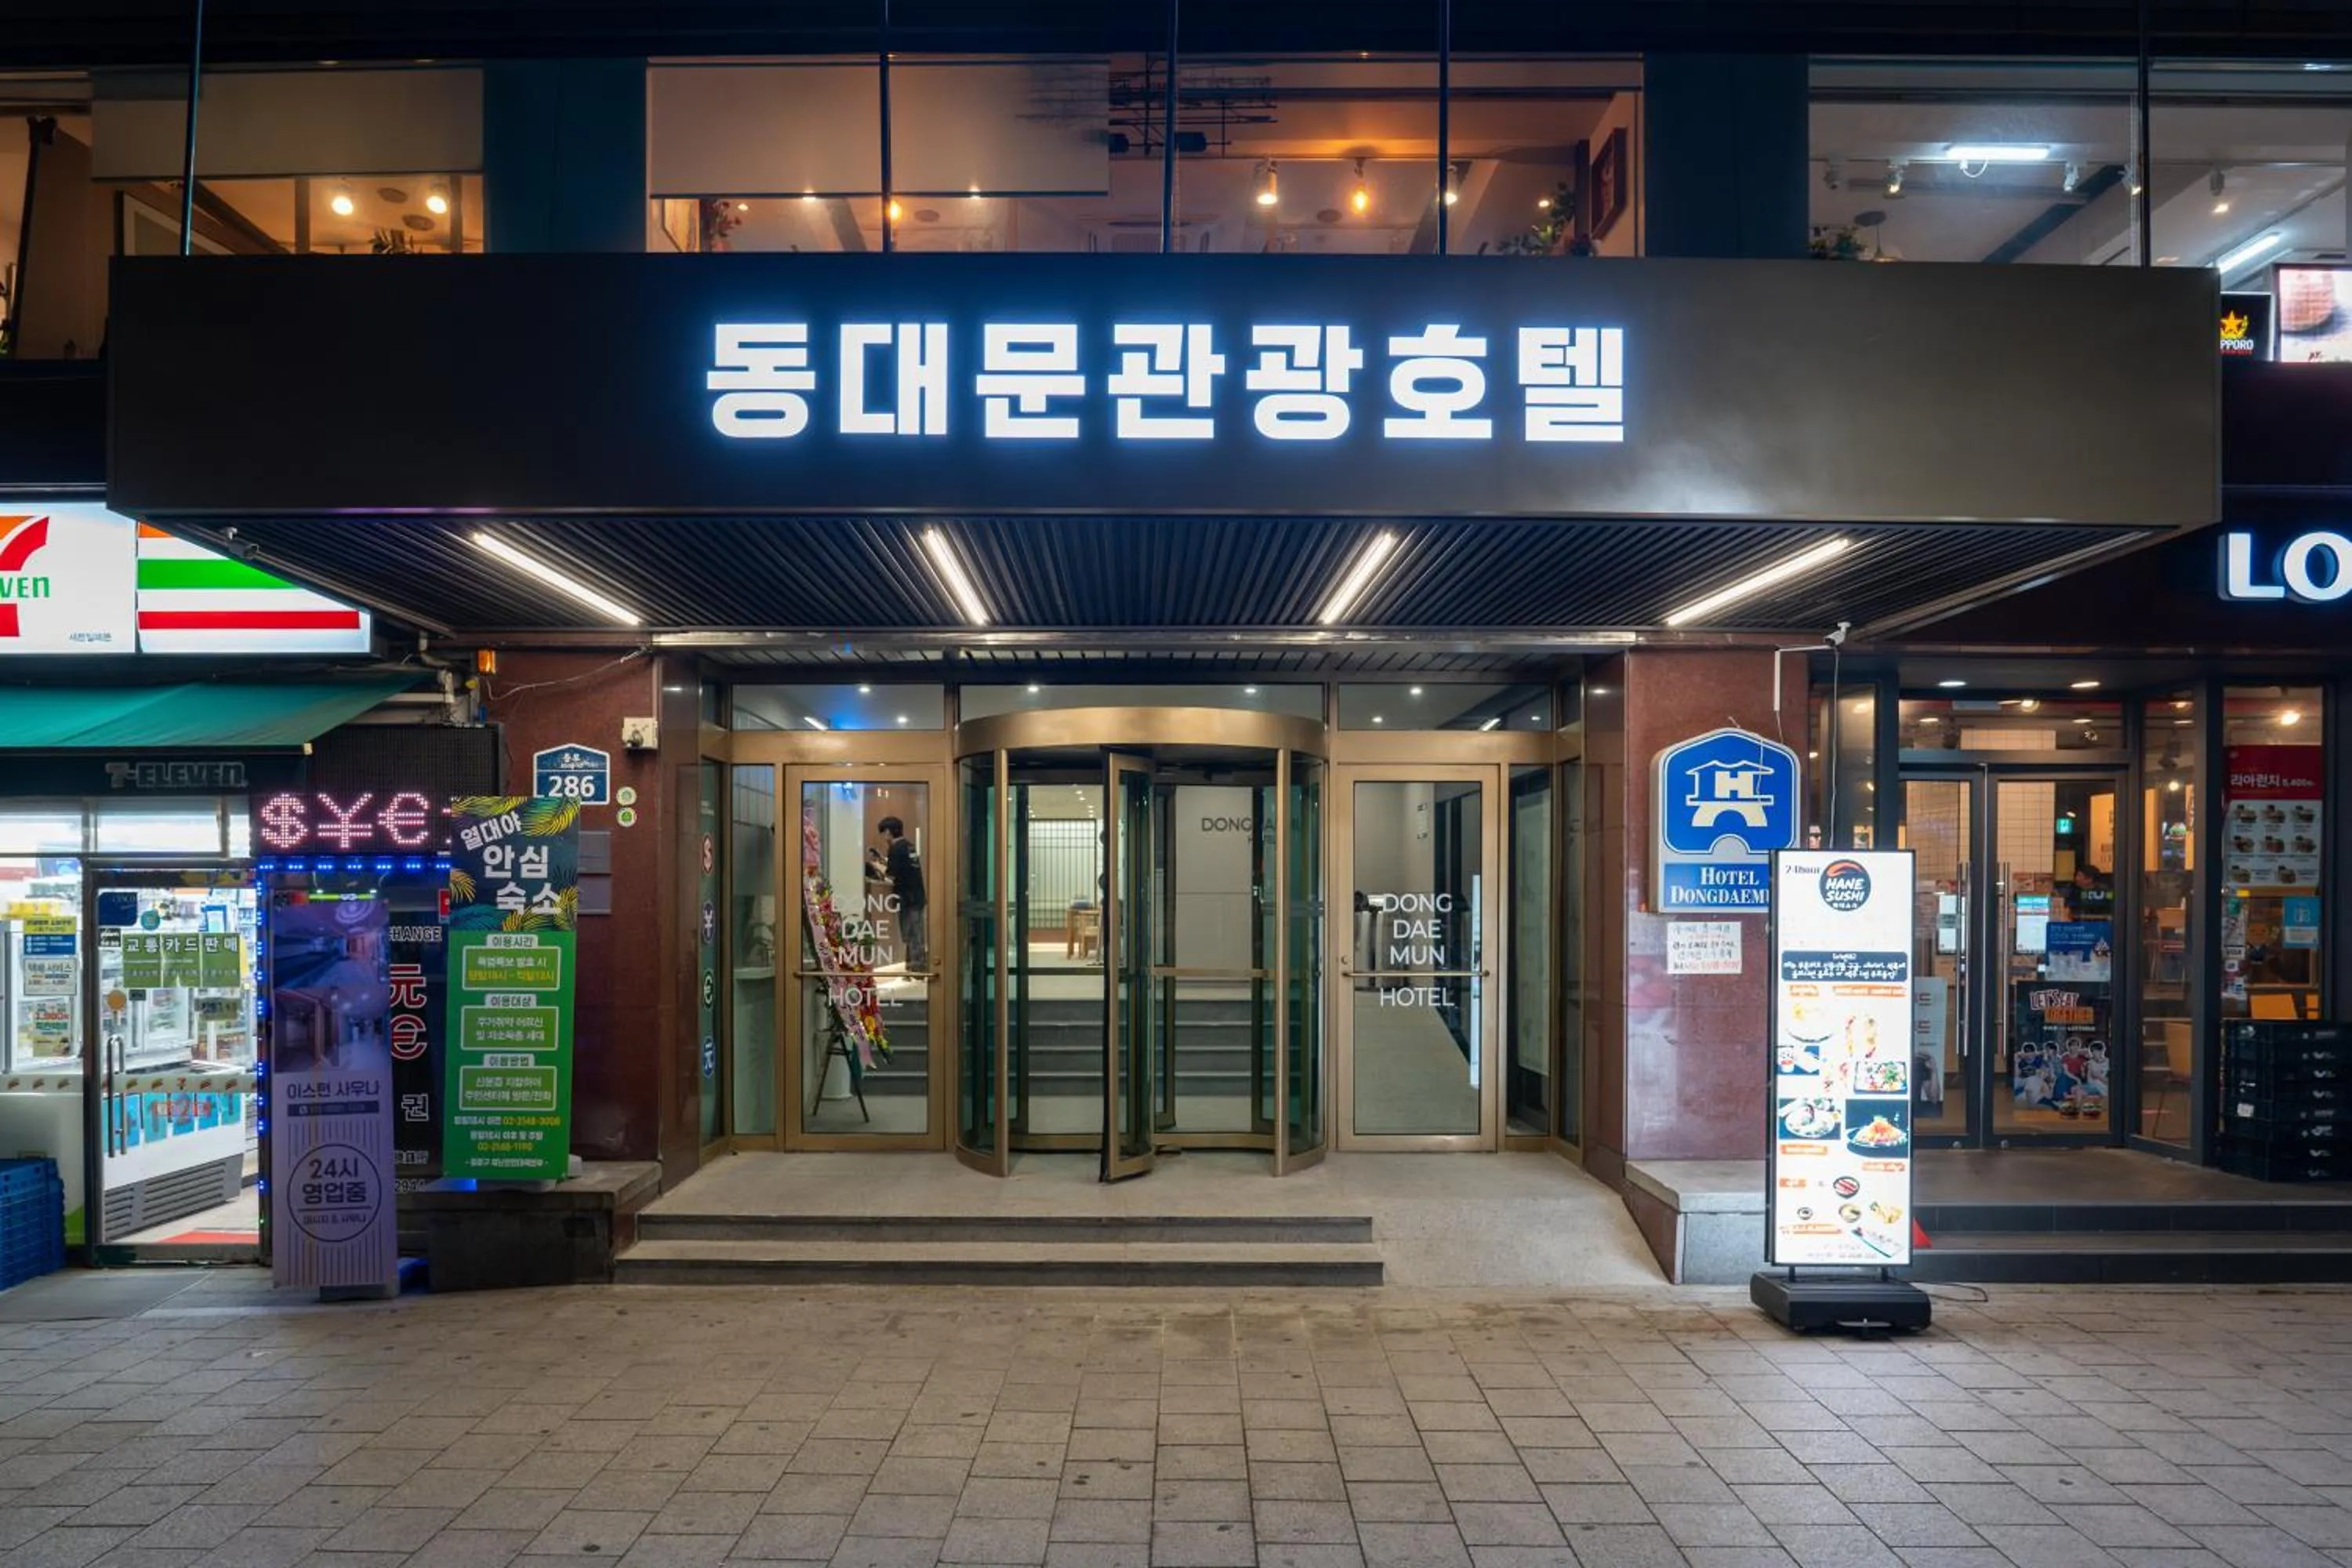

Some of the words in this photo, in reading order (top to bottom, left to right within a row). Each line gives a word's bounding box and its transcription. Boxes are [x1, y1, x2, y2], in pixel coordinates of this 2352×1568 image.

[707, 322, 1624, 441] 동대문관광호텔
[549, 775, 595, 797] 286
[460, 811, 522, 851] 열대야
[483, 844, 548, 879] 안심
[1825, 877, 1866, 891] HANE
[495, 881, 562, 916] 숙소
[1382, 892, 1454, 913] DONG
[1824, 891, 1865, 902] SUSHI
[389, 925, 442, 942] HANGE
[841, 920, 891, 939] DAE
[1392, 919, 1443, 939] DAE
[492, 935, 534, 948] 이용시간
[838, 945, 893, 965] MUN
[1390, 945, 1445, 966] MUN
[829, 987, 904, 1007] HOTEL
[1380, 987, 1456, 1007] HOTEL
[287, 1082, 332, 1099] 이스턴
[336, 1080, 379, 1098] 사우나
[309, 1157, 358, 1179] 24시
[303, 1181, 366, 1204] 영업중
